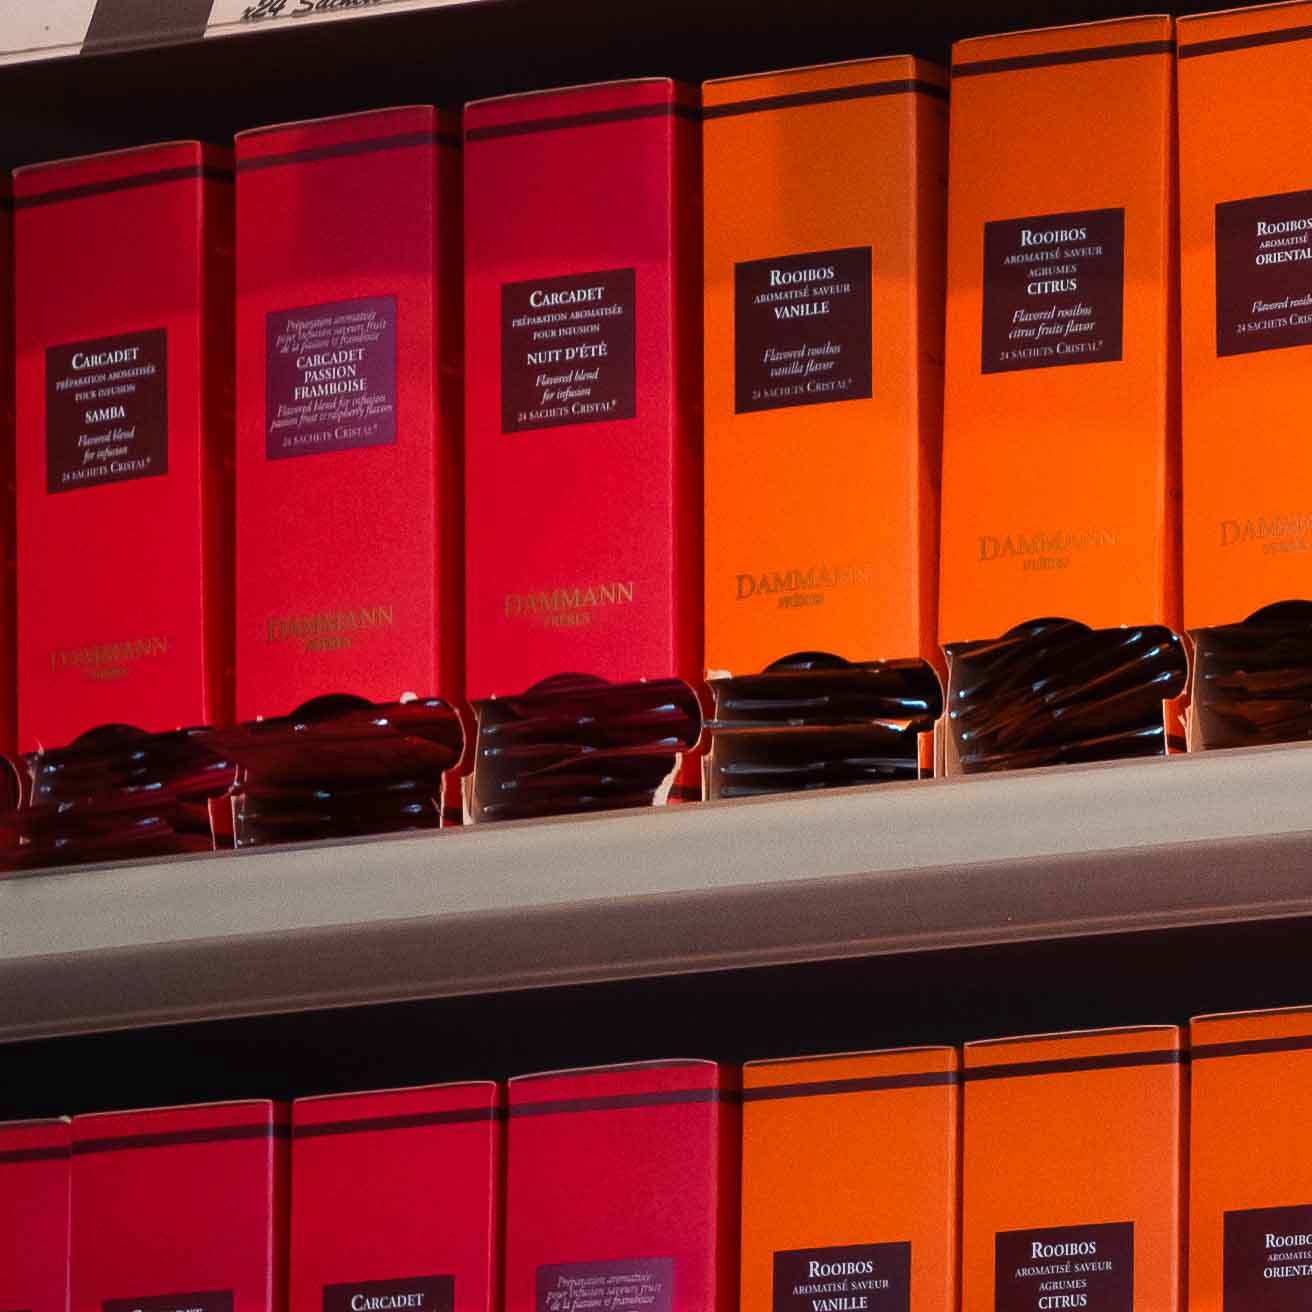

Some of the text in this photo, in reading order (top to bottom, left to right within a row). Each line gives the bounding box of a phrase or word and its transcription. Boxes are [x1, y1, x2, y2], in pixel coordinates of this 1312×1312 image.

[1020, 225, 1086, 248] ROOIBOS
[1027, 277, 1077, 296] CITRUS
[529, 286, 604, 310] CARCADET
[526, 348, 561, 365] NUIT
[808, 1259, 873, 1278] ROOIBOS
[350, 1293, 425, 1312] CARCADET
[812, 1296, 868, 1312] VANILLE
